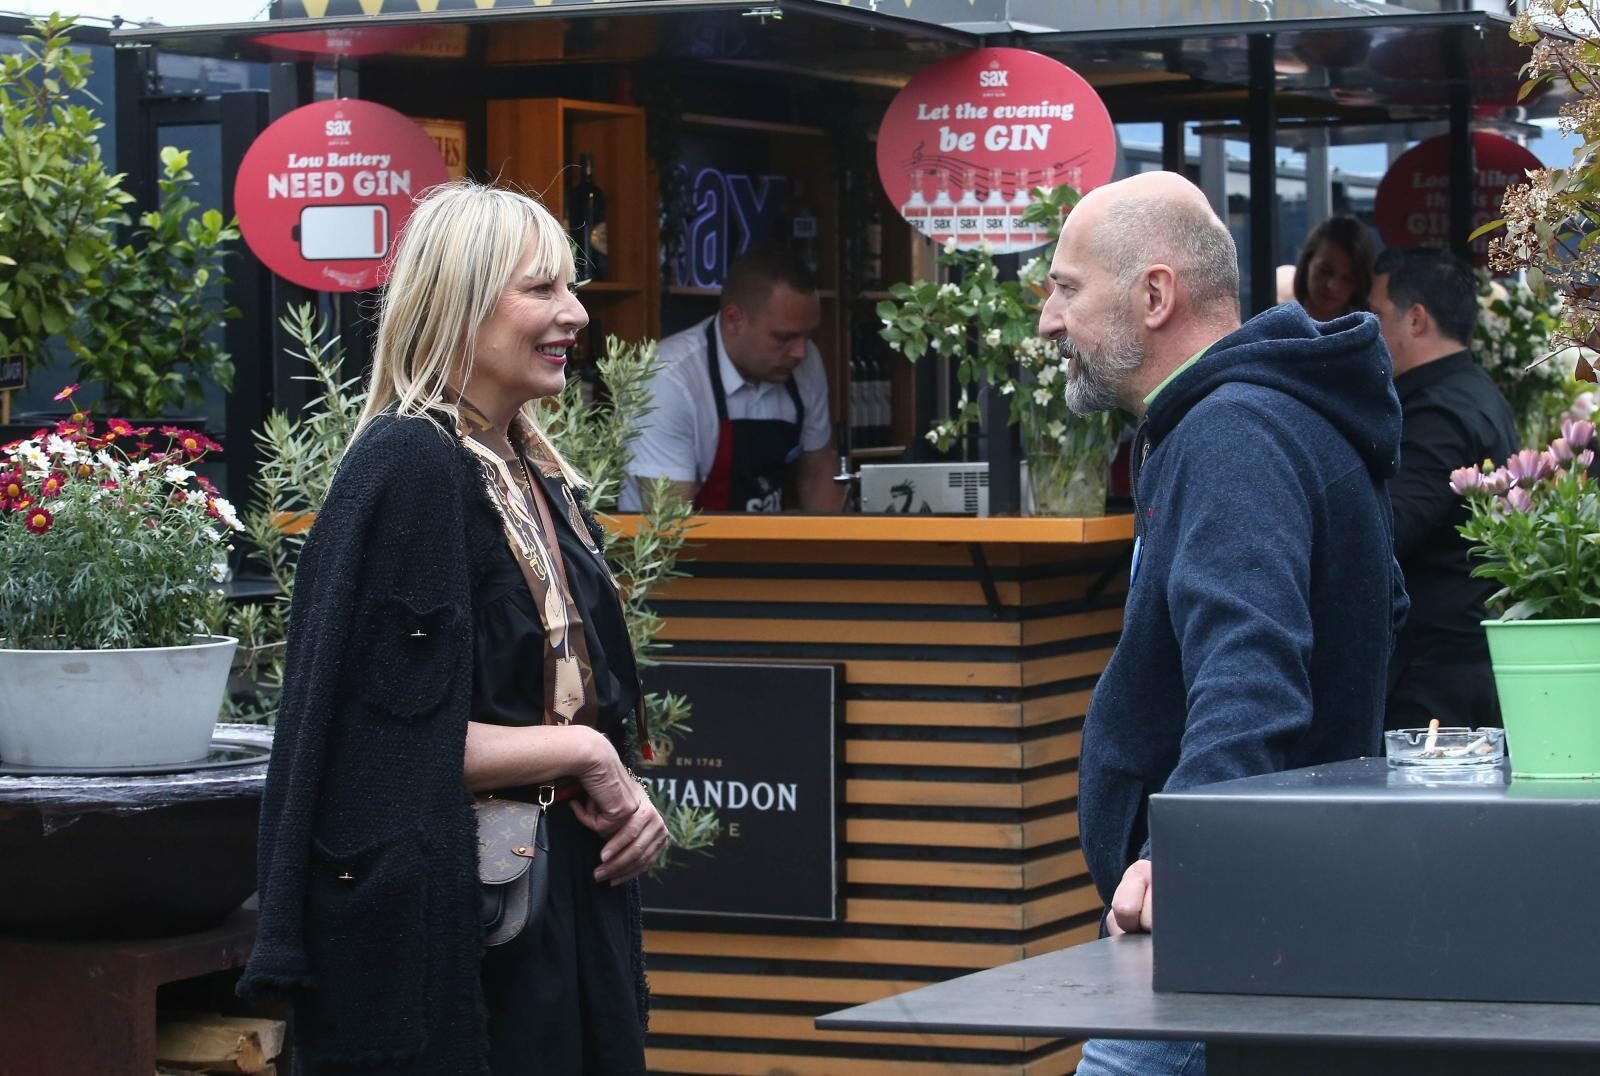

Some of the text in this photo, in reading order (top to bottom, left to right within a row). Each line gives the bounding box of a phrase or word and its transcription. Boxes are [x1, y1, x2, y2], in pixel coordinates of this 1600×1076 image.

[980, 71, 1008, 87] sax
[917, 101, 1075, 122] Let the evening
[325, 120, 351, 136] sax
[938, 124, 1052, 152] be GIN
[287, 152, 391, 169] Low Battery
[267, 170, 411, 199] NEED GIN
[934, 218, 951, 229] sax
[960, 218, 977, 229] sax
[986, 218, 1003, 229] sax
[676, 757, 692, 766] EN
